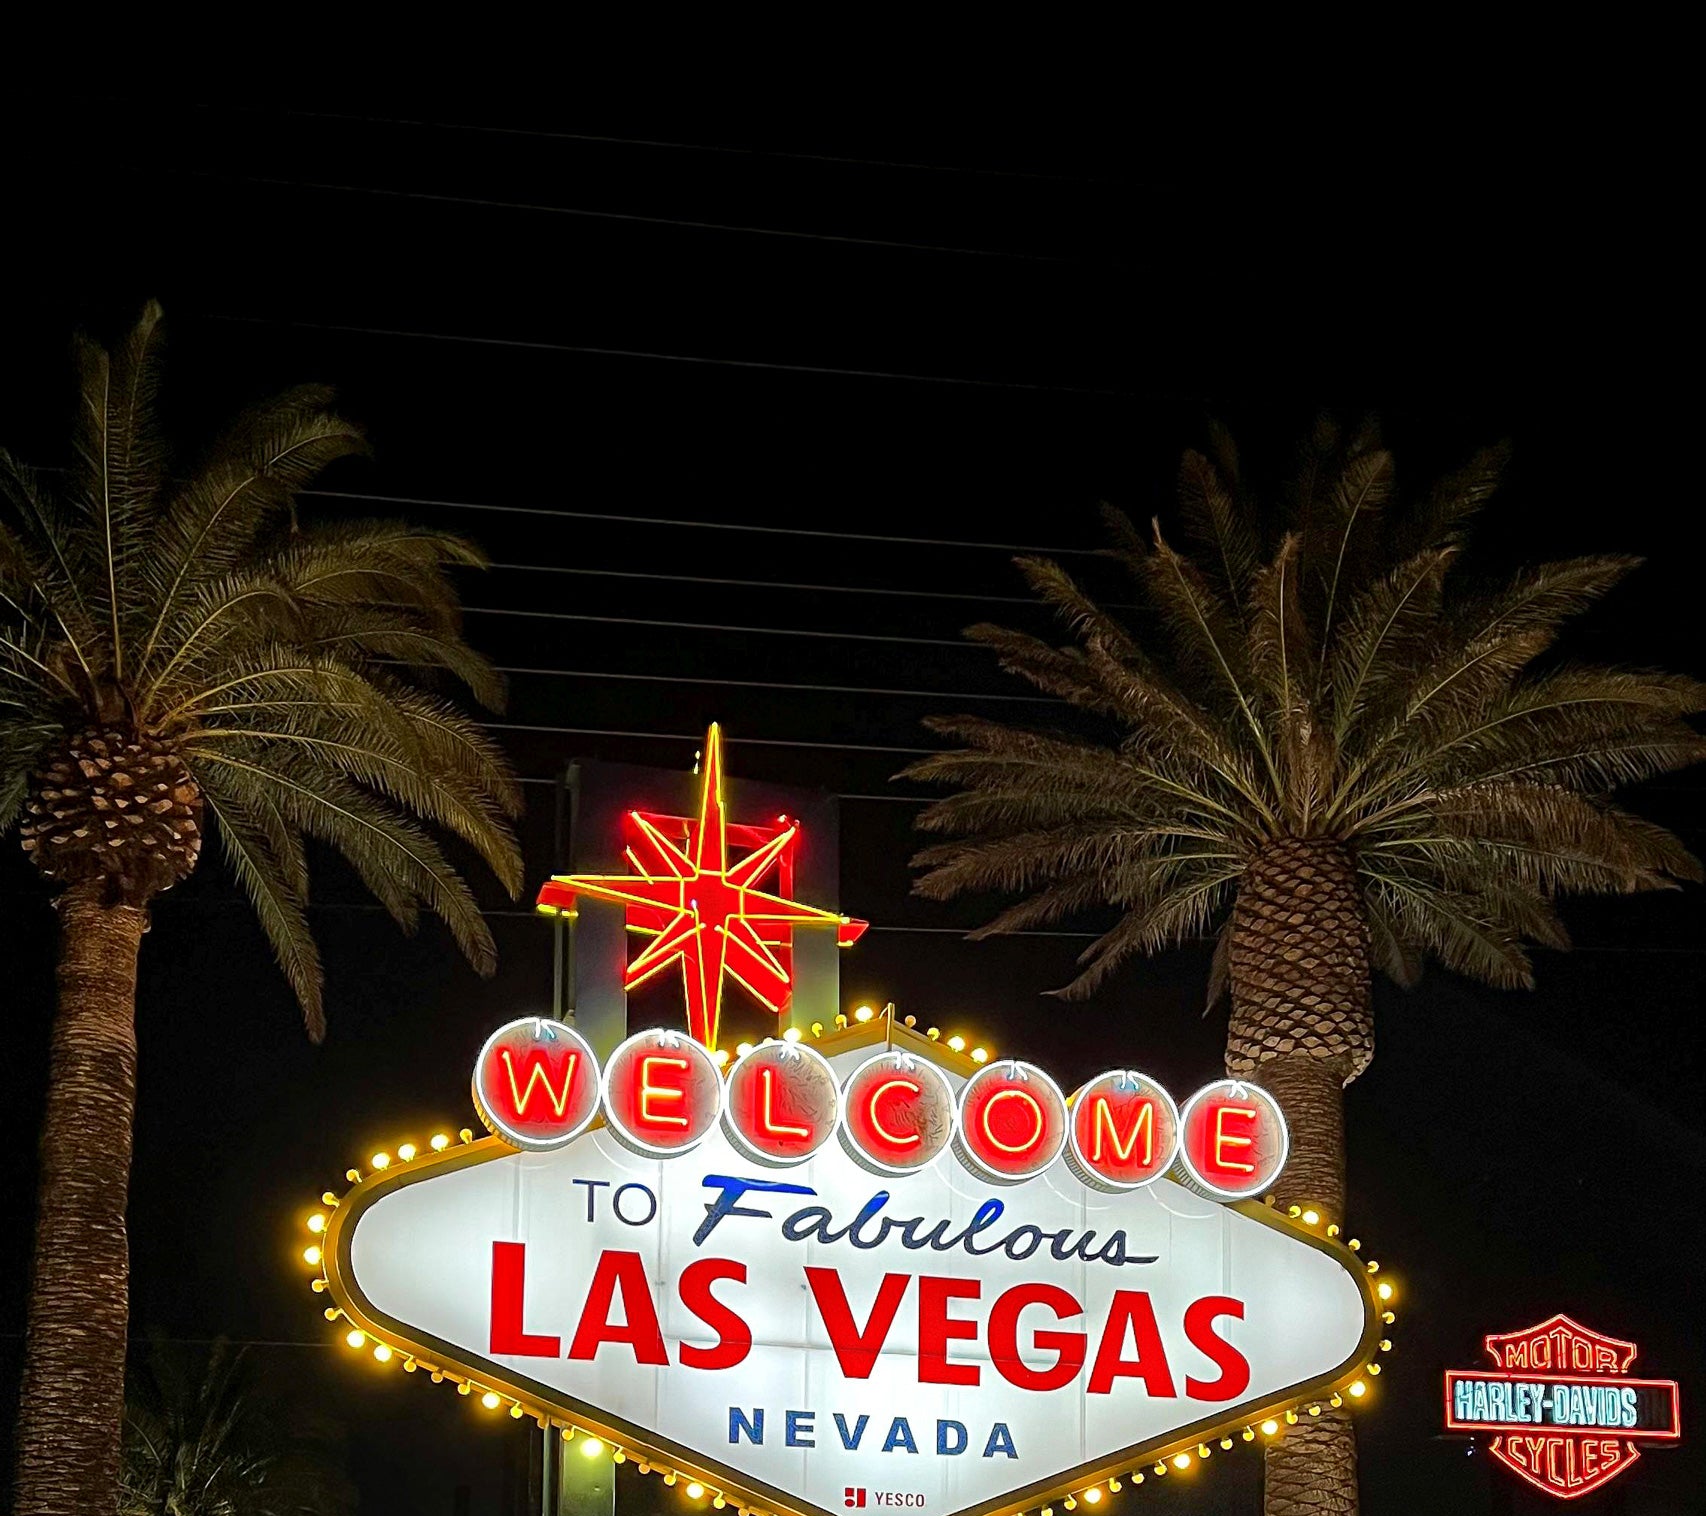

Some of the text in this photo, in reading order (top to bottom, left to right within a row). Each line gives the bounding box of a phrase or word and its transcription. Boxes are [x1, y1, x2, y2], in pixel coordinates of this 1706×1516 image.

[499, 1047, 1256, 1173] WELCOME
[573, 1174, 1159, 1267] TO Fabulous
[490, 1241, 1251, 1401] LAS VEGAS
[1505, 1327, 1618, 1372] MOTOR
[728, 1406, 1019, 1460] NEVADA
[1507, 1437, 1620, 1487] CYCLES
[875, 1491, 925, 1508] YESCO
